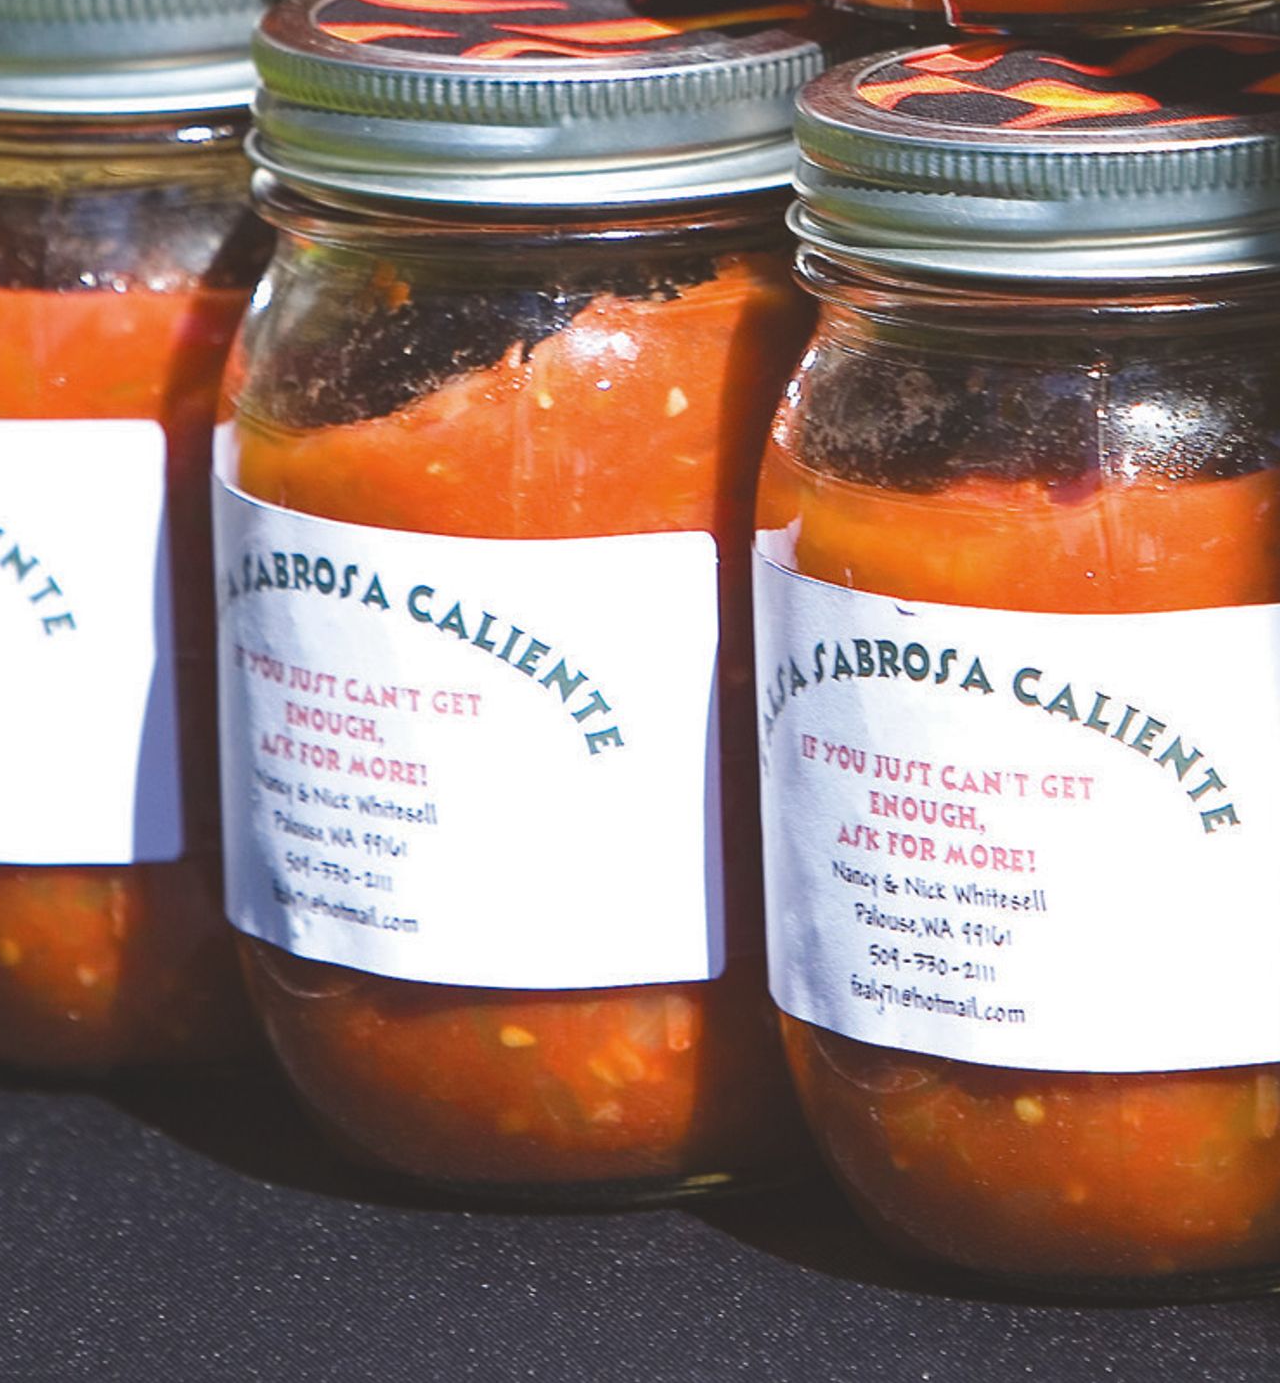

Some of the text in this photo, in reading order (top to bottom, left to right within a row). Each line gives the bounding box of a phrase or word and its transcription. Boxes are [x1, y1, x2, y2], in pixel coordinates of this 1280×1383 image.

[241, 551, 625, 756] SABROSA CALIENTE
[289, 665, 338, 699] JUST
[344, 677, 421, 713] CAN'T
[432, 690, 482, 718] GET
[285, 700, 386, 748] ENOUGH,
[813, 637, 995, 696] SABROSA
[1012, 666, 1242, 835] CALIENTE
[299, 741, 341, 772] FOR
[347, 754, 428, 787] MORE!
[800, 732, 1095, 801] IF YOU JUST CAN'T GET
[868, 789, 988, 836] ENOUGH,
[836, 820, 1037, 874] ASK FOR MORE!
[831, 859, 1048, 912] Nancy & Nick Whitesell
[961, 921, 1013, 947] 99161
[868, 943, 997, 983] 509-330-2111
